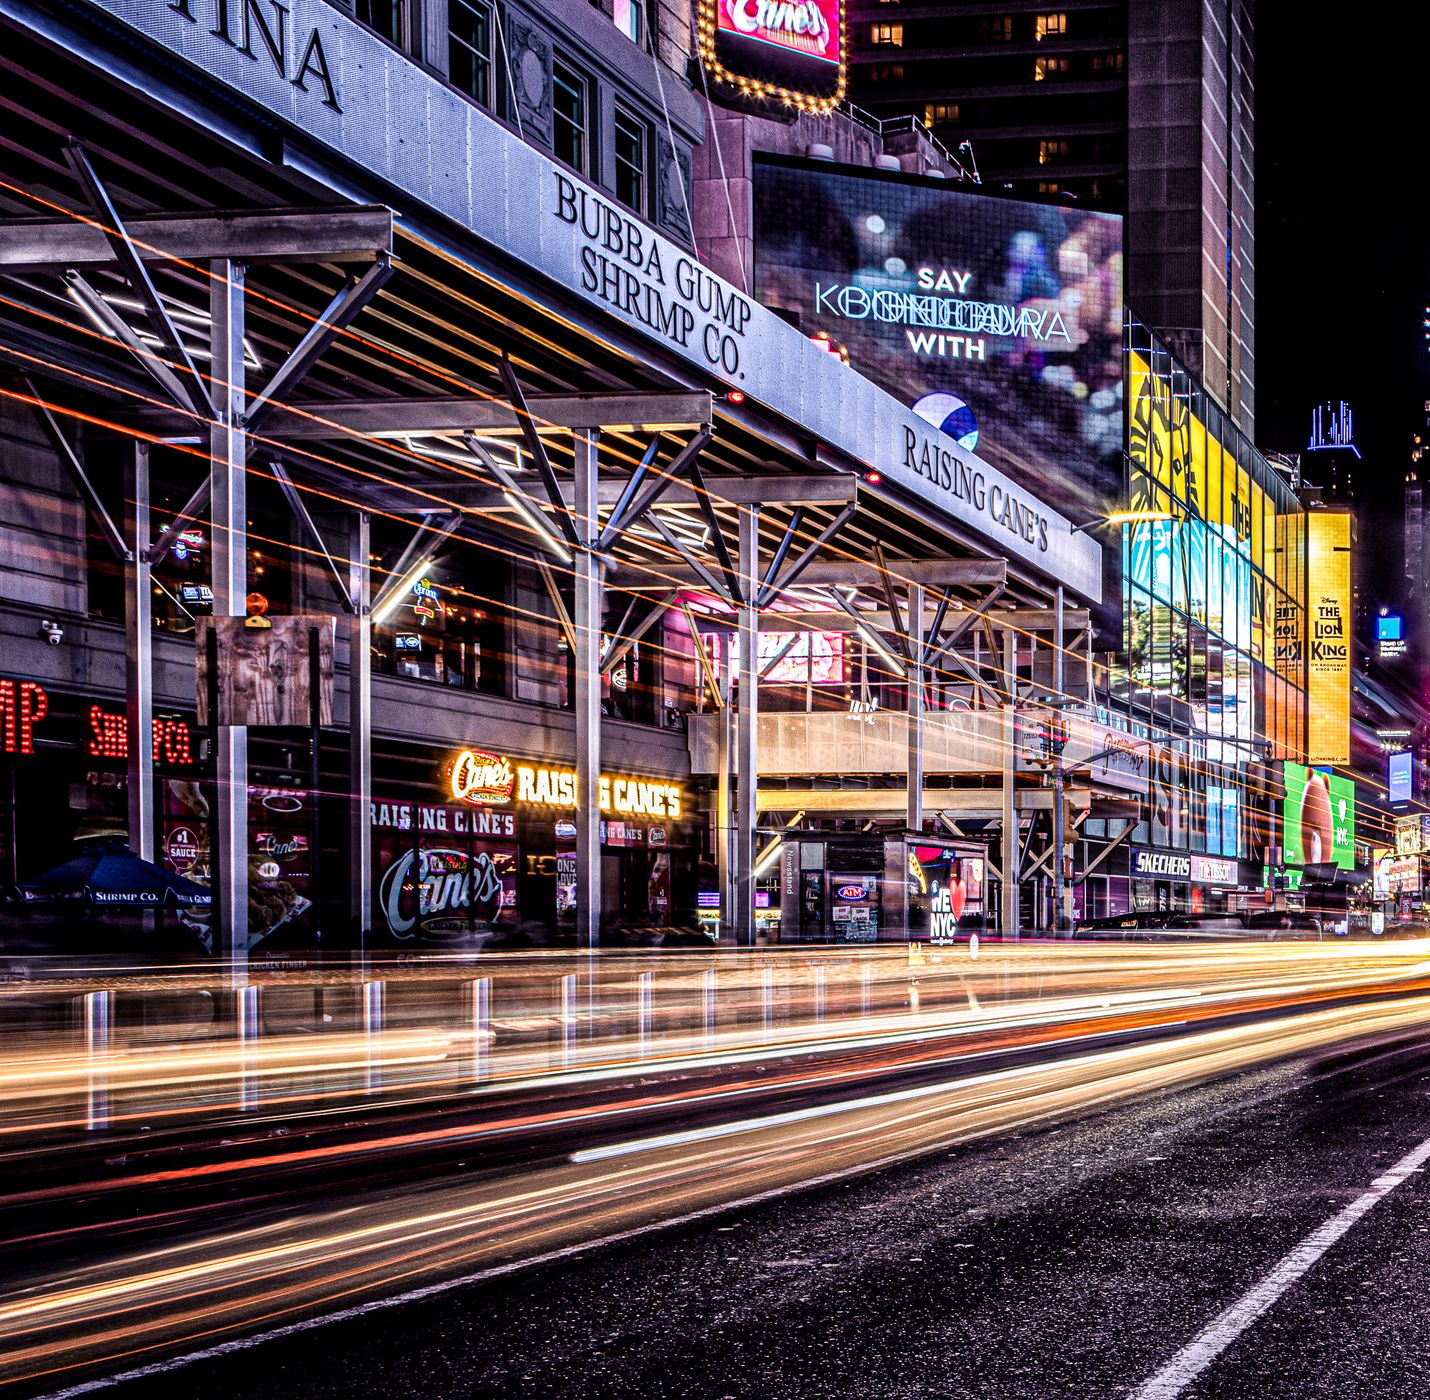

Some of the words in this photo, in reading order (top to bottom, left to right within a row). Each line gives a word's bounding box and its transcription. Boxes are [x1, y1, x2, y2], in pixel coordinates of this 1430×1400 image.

[167, 0, 344, 115] INA
[553, 172, 666, 286] BUBBA
[676, 257, 751, 337] GUMP
[917, 267, 972, 294] SAY
[580, 245, 695, 348] SHRIMP
[703, 323, 745, 380] CO.
[906, 330, 986, 361] WITH
[902, 424, 985, 512] RAISING
[990, 484, 1048, 553] CANE'S
[1318, 606, 1340, 617] THE
[1314, 617, 1343, 639] LION
[1311, 641, 1347, 661] KING
[90, 704, 164, 760] SHRP
[452, 751, 514, 799] Cane's
[517, 767, 610, 810] RAISIG
[614, 780, 680, 817] CANE'S
[455, 811, 514, 835] CANE'S
[177, 830, 188, 843] #1
[1336, 825, 1349, 847] NYC
[171, 848, 196, 858] SAUCE
[557, 858, 576, 872] ONE
[1137, 851, 1191, 877] SKECHERS
[557, 873, 577, 886] LOVE
[785, 849, 794, 896] Newsstand
[96, 891, 137, 901] SHRIMP
[140, 892, 159, 901] CO.
[388, 848, 501, 932] Cane's
[843, 888, 862, 897] ATM
[931, 888, 951, 912] WE
[930, 912, 956, 937] NYC
